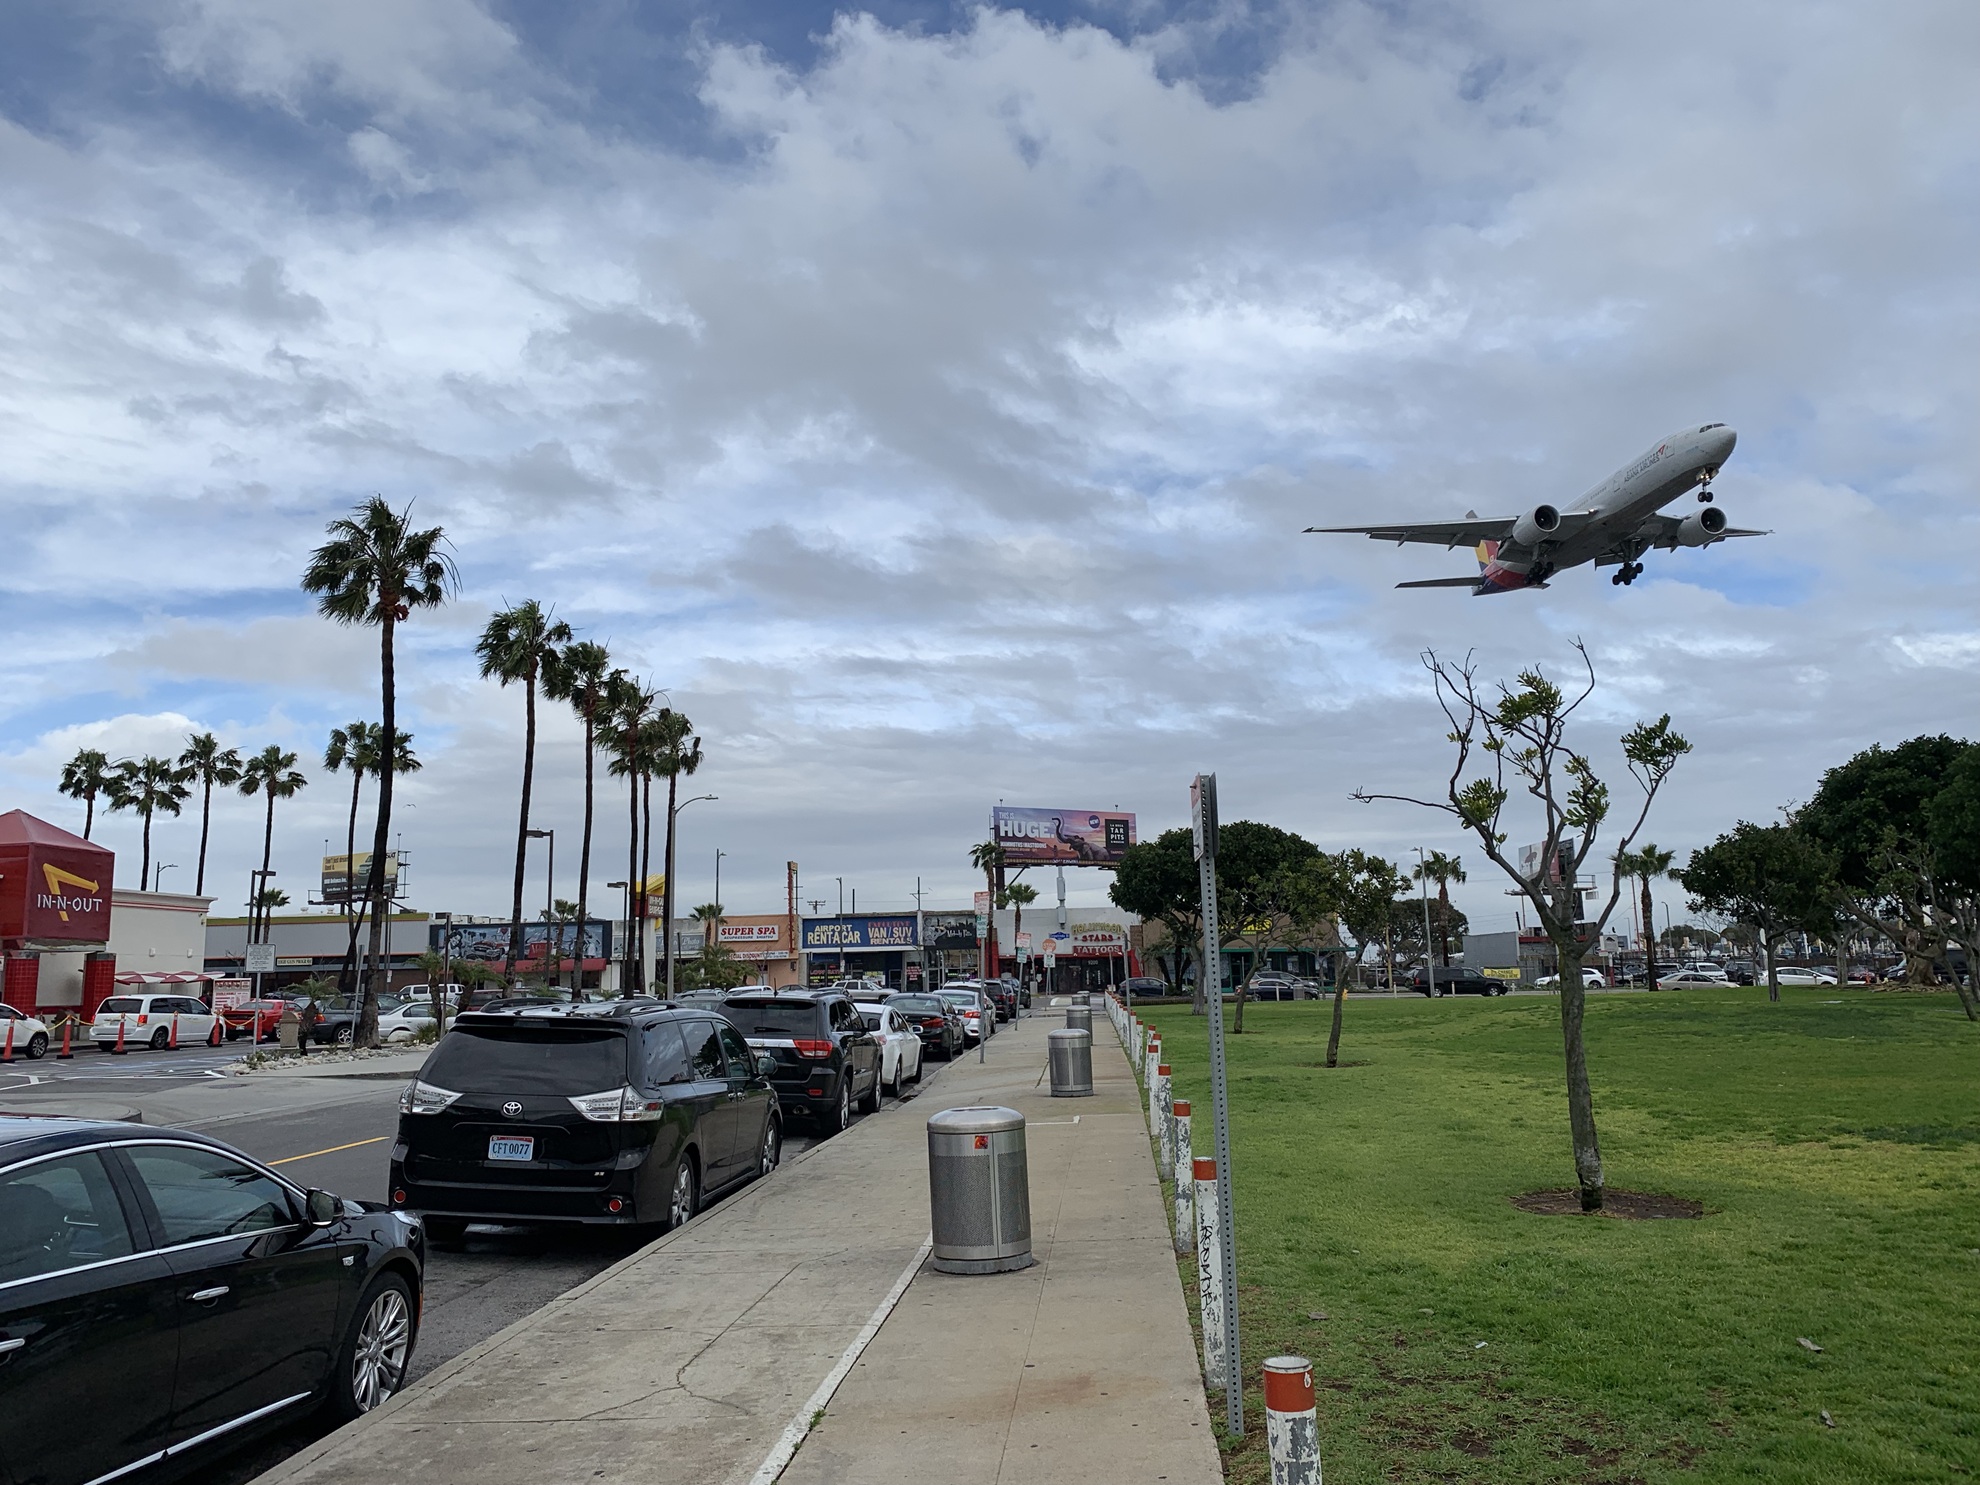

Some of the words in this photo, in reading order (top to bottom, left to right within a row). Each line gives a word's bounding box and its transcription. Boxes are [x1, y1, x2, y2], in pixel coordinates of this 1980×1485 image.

[1624, 469, 1639, 482] ASIANA
[1640, 455, 1660, 471] AIRLINES
[999, 811, 1009, 820] THIS
[1010, 812, 1015, 820] IS
[999, 820, 1055, 839] HUGE.
[37, 893, 103, 912] IN-N-OUT
[720, 927, 754, 936] SUPER
[757, 926, 776, 935] SPA
[814, 924, 852, 932] AIRPORT
[867, 927, 887, 938] VAN
[892, 926, 913, 938] SUV
[1071, 922, 1122, 935] HOLLYWOOD
[870, 937, 913, 945] RENTALS
[1081, 933, 1114, 942] STARS
[1076, 945, 1120, 954] TATTOOS
[492, 1142, 508, 1154] CFT
[508, 1143, 530, 1155] 0077
